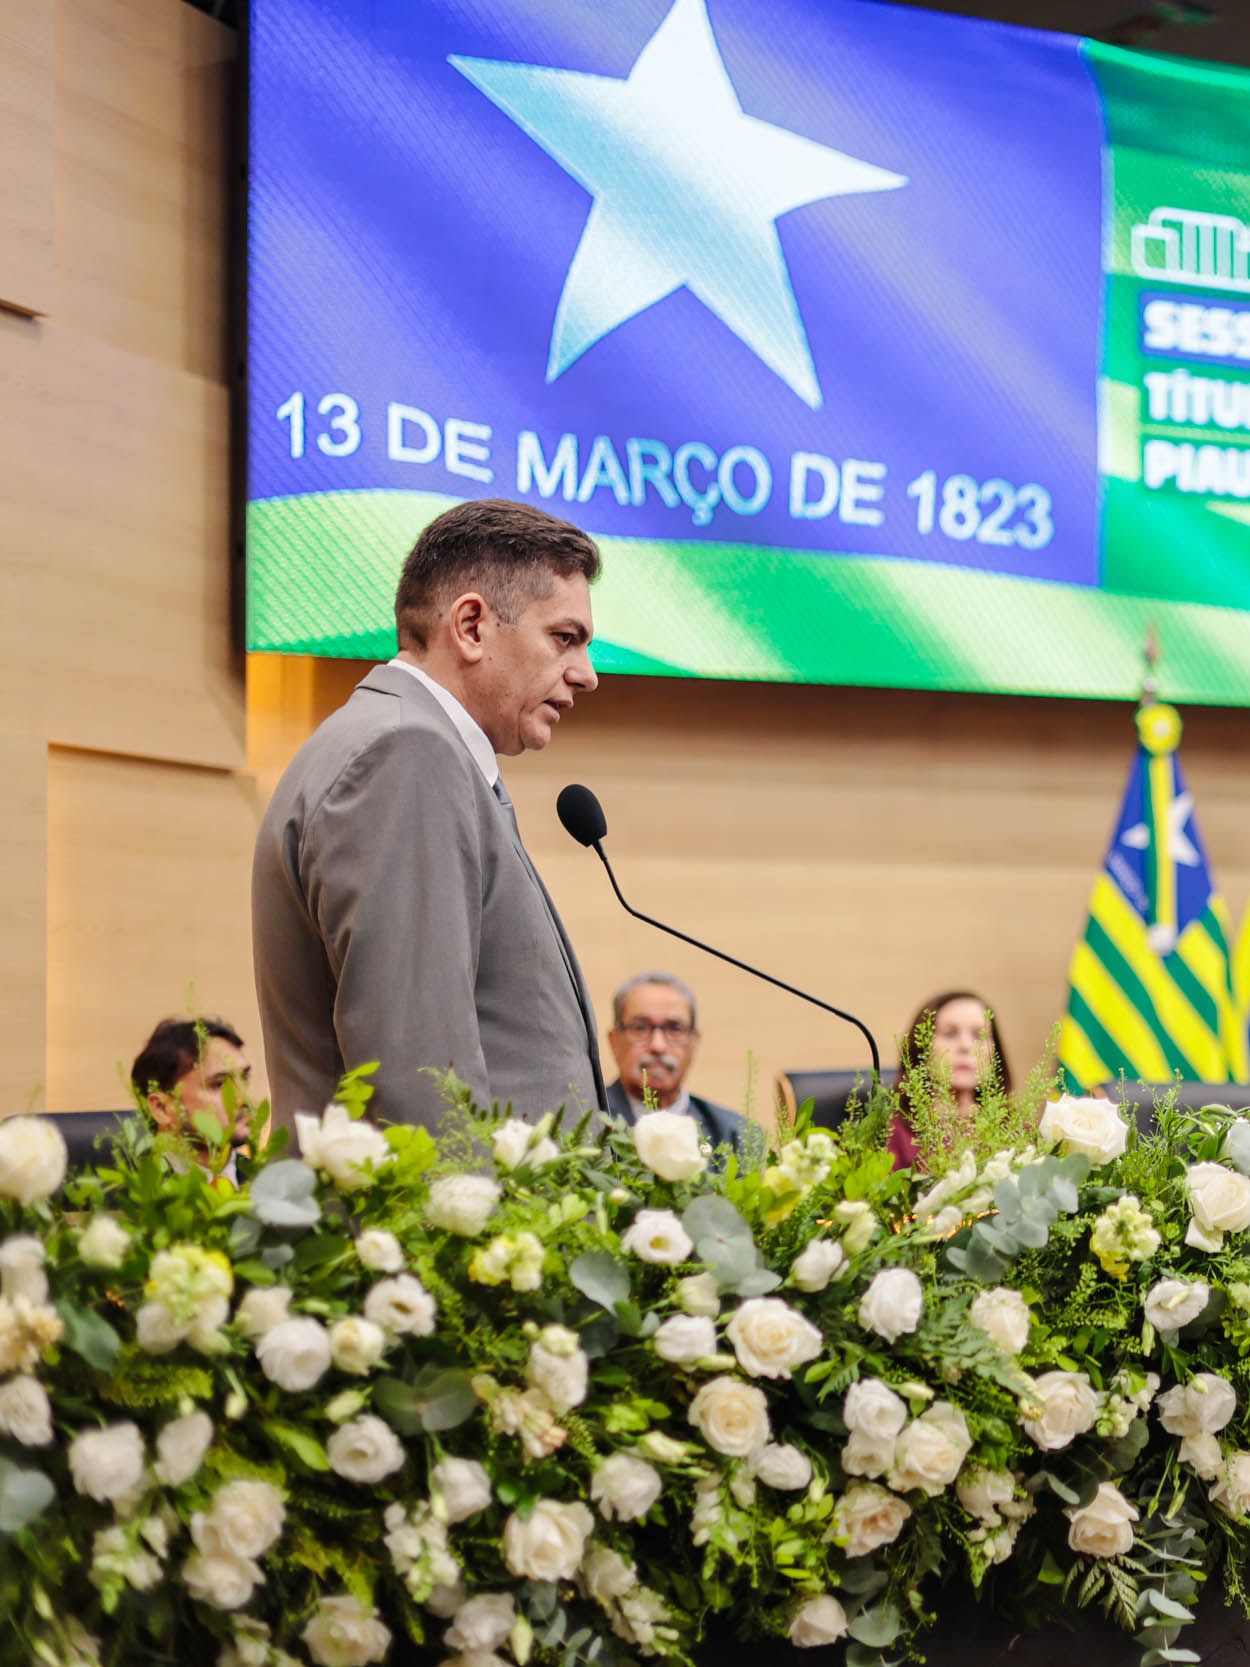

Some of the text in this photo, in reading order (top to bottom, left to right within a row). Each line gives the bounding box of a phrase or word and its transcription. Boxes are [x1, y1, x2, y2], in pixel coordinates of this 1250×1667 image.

[276, 392, 1055, 551] 13 DE MARÇO DE 1823
